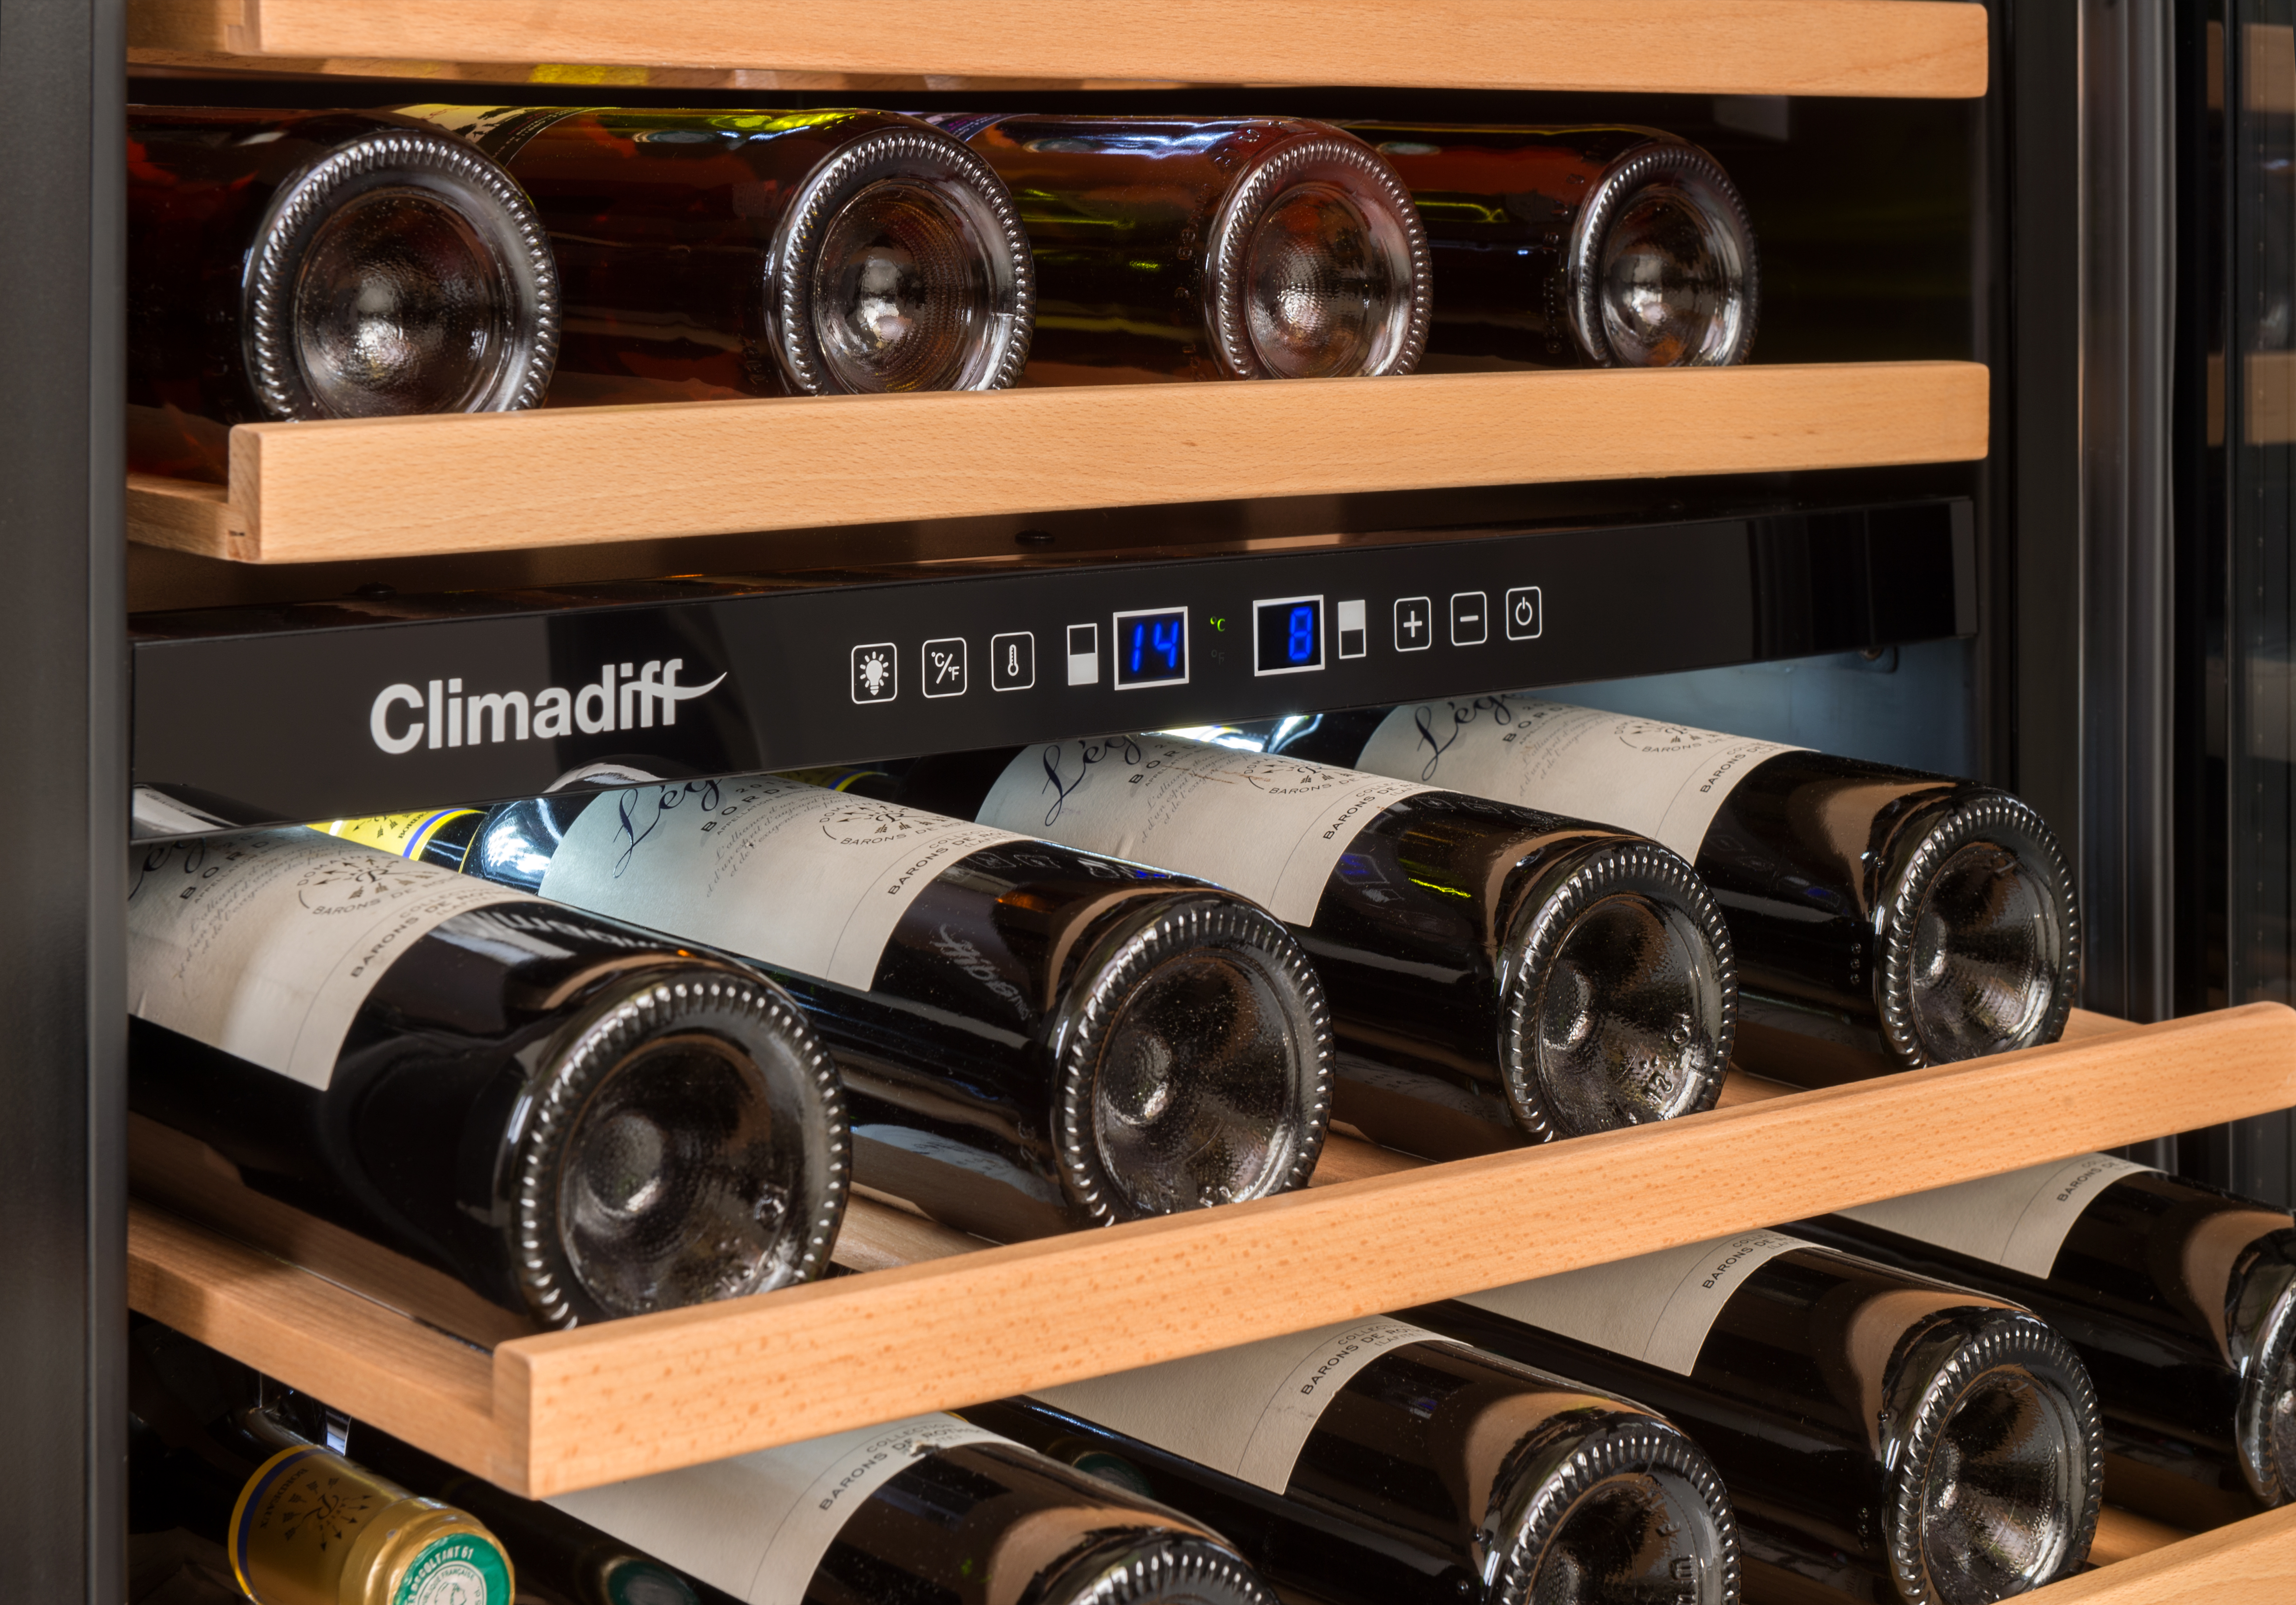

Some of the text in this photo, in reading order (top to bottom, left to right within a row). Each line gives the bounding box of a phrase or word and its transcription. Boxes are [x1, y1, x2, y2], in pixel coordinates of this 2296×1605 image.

[1131, 621, 1179, 672] 14
[1288, 607, 1313, 661] 8
[370, 658, 728, 754] Climadiff
[1128, 745, 1196, 784] BORD
[1642, 742, 1702, 753] BARONS
[1269, 783, 1332, 794] BARONS
[1700, 753, 1746, 793] BARONS
[717, 798, 773, 835] APPELLATION
[840, 833, 907, 845] BARONS
[1323, 795, 1375, 840] BARONS
[888, 837, 977, 895] BARONS DE
[313, 888, 416, 915] BARONS DE
[350, 901, 452, 978] BARONS DE
[2057, 1166, 2103, 1203] BARONS
[1702, 1239, 1775, 1290] BARONS DE
[1300, 1333, 1385, 1396] BARONS DE
[260, 1468, 309, 1530] BORDEAUX
[819, 1450, 888, 1511] BARONS
[461, 1546, 474, 1561] 61
